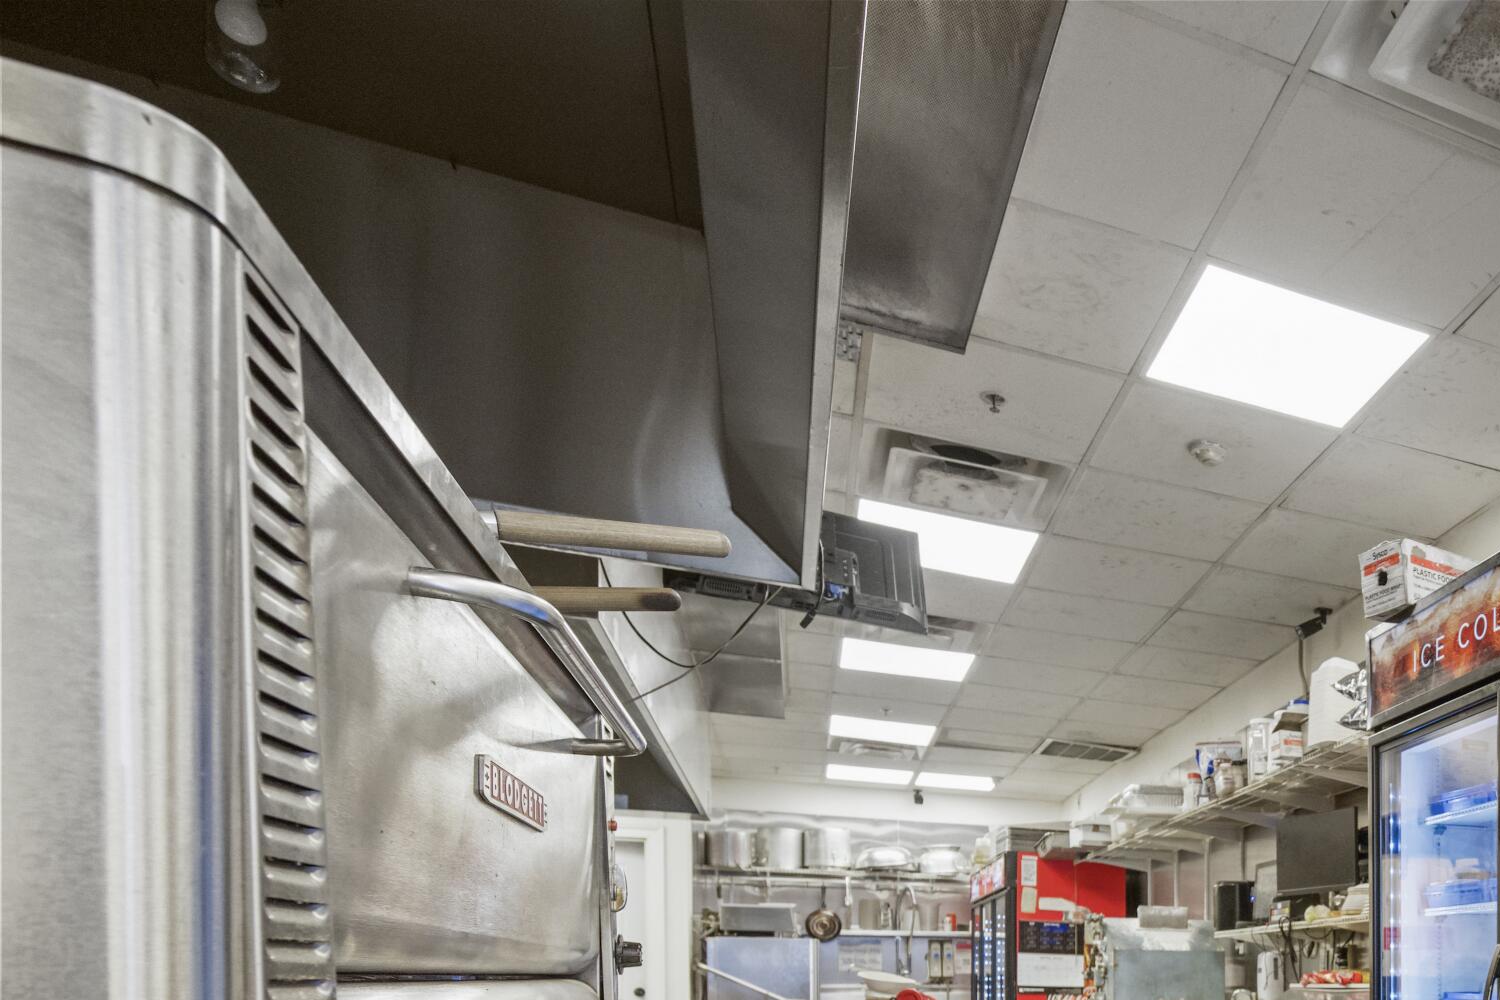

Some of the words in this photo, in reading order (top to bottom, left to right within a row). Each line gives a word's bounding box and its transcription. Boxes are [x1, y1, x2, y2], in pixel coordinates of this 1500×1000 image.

[1412, 567, 1437, 580] PLASTIC
[1412, 635, 1445, 673] ICE
[492, 764, 543, 823] BLODGETT
